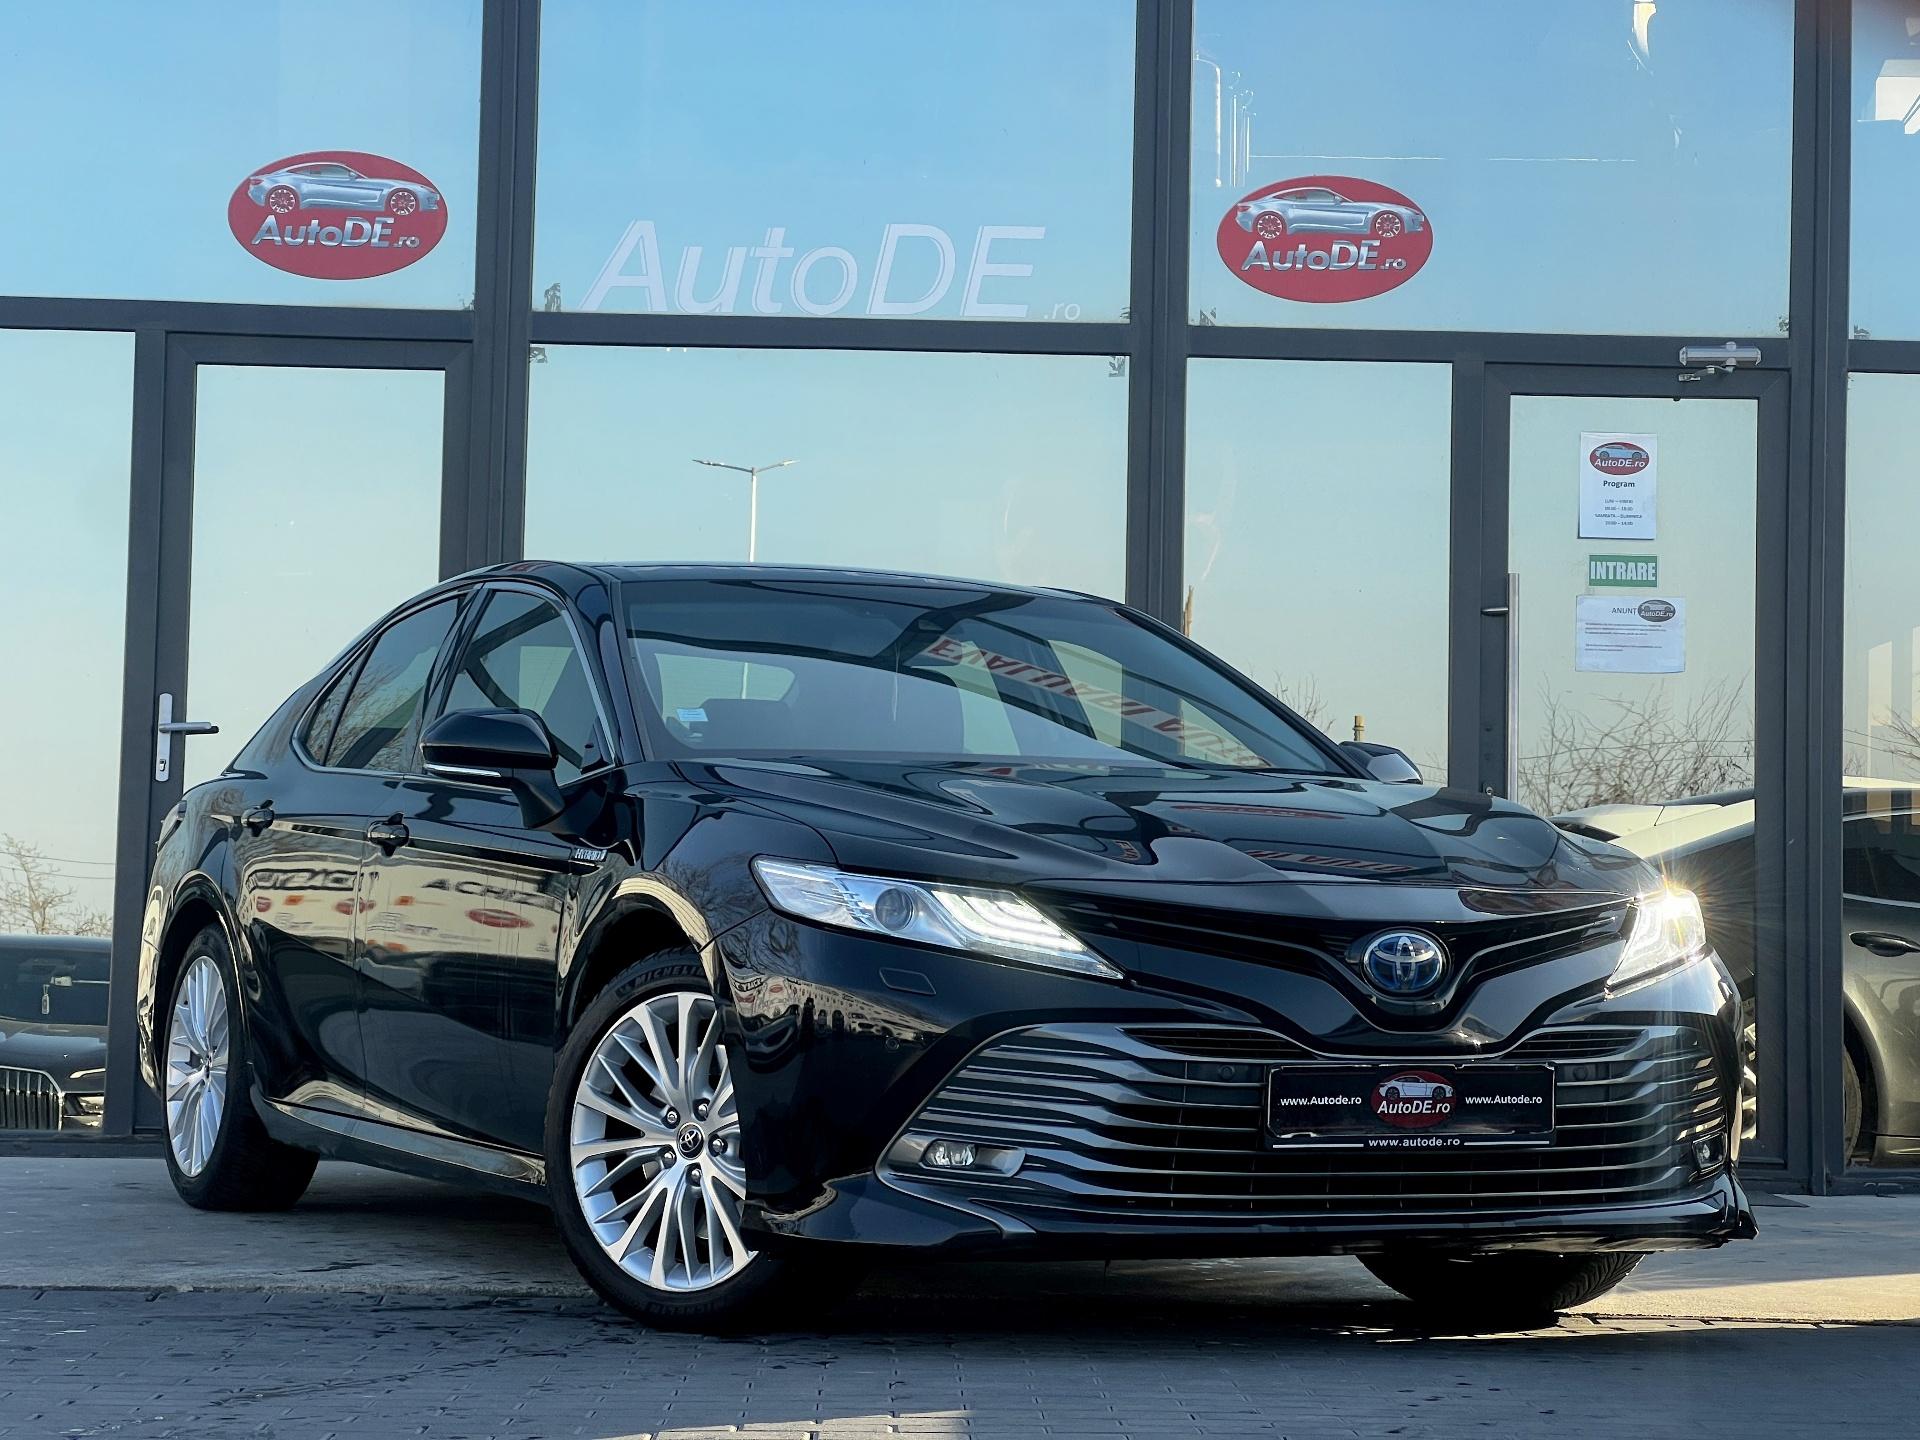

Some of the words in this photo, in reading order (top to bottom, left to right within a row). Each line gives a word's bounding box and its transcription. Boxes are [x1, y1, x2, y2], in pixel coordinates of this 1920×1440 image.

[1594, 459, 1646, 468] AutoDE.ro
[1603, 480, 1636, 489] Program
[1590, 561, 1656, 581] INTRARE
[1279, 1094, 1362, 1107] www.Autode.ro
[1465, 1094, 1543, 1106] www.Autode.ro
[1377, 1099, 1451, 1115] AutoDE.ro
[1368, 1136, 1461, 1148] www.autode.ro
